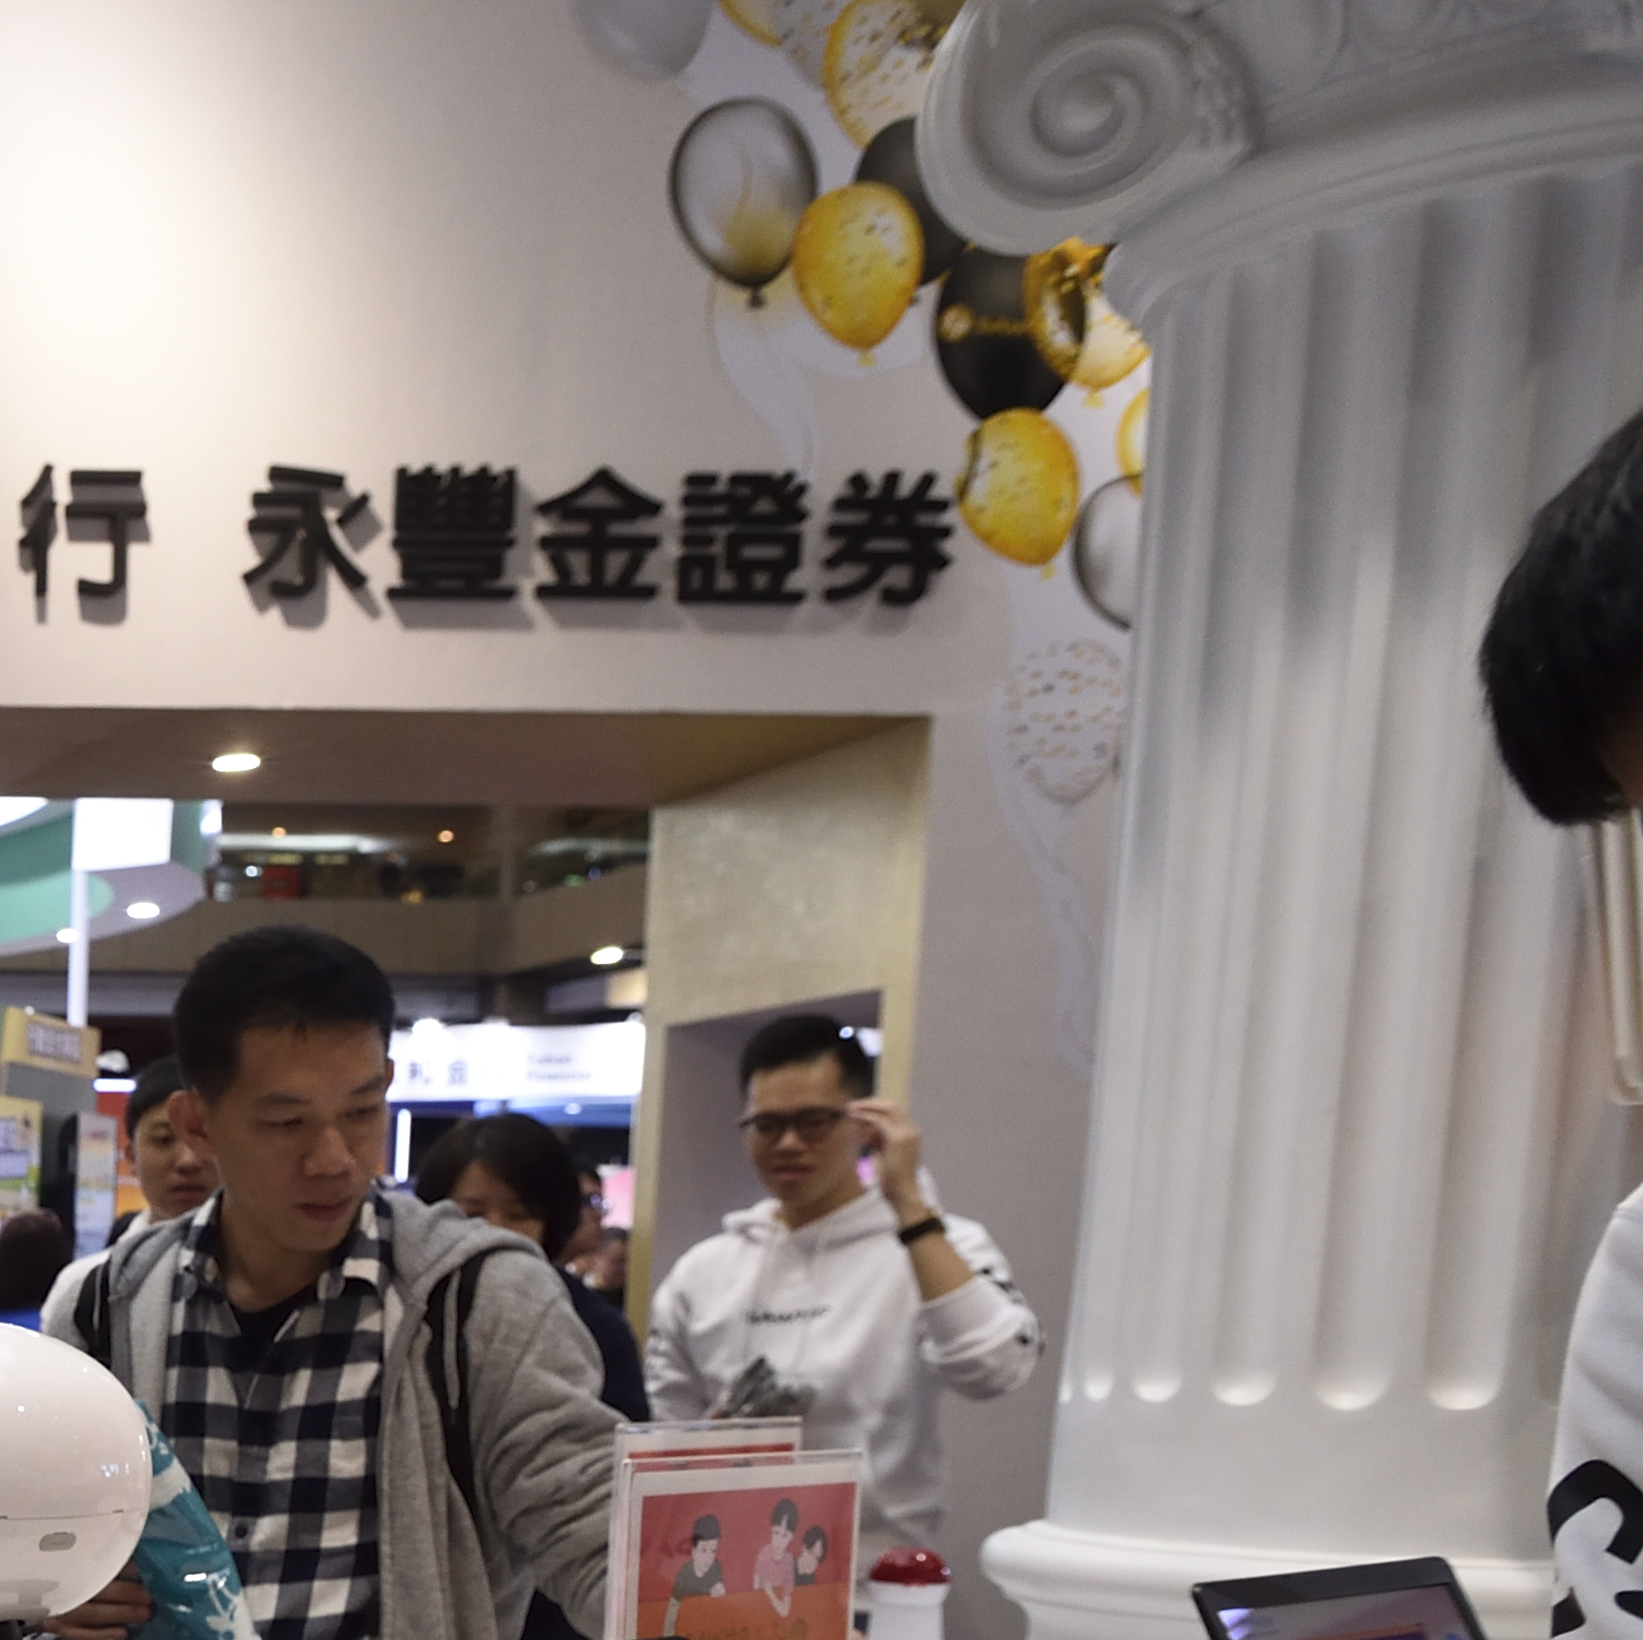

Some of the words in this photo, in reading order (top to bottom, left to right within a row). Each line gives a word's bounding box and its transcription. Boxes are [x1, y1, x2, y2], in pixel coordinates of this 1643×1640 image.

[241, 463, 953, 602] 永豐金證券
